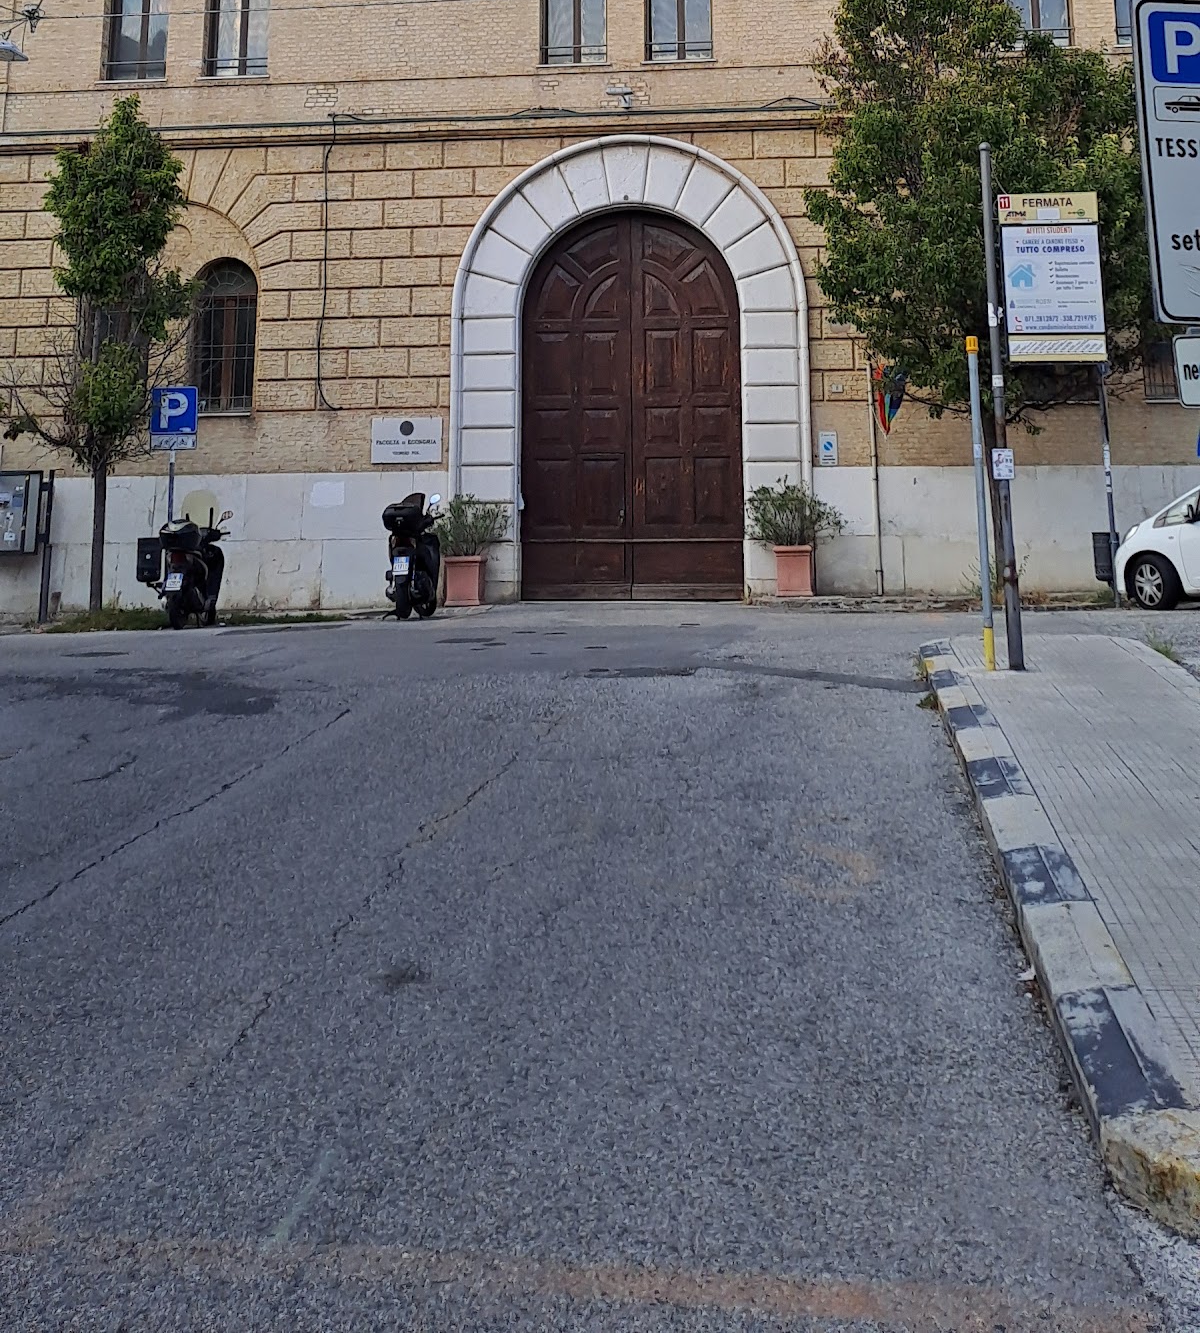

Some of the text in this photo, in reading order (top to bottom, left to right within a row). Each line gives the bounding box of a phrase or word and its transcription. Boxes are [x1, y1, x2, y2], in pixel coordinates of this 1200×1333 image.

[1163, 20, 1200, 74] P
[1155, 137, 1200, 158] TESS
[1000, 198, 1009, 208] 11
[1022, 197, 1073, 208] FERMATA
[1047, 226, 1073, 234] STUDENTI
[1171, 229, 1200, 251] set
[1016, 245, 1086, 254] TUTTO COMPRESO
[1183, 363, 1200, 381] ne
[160, 391, 189, 428] P
